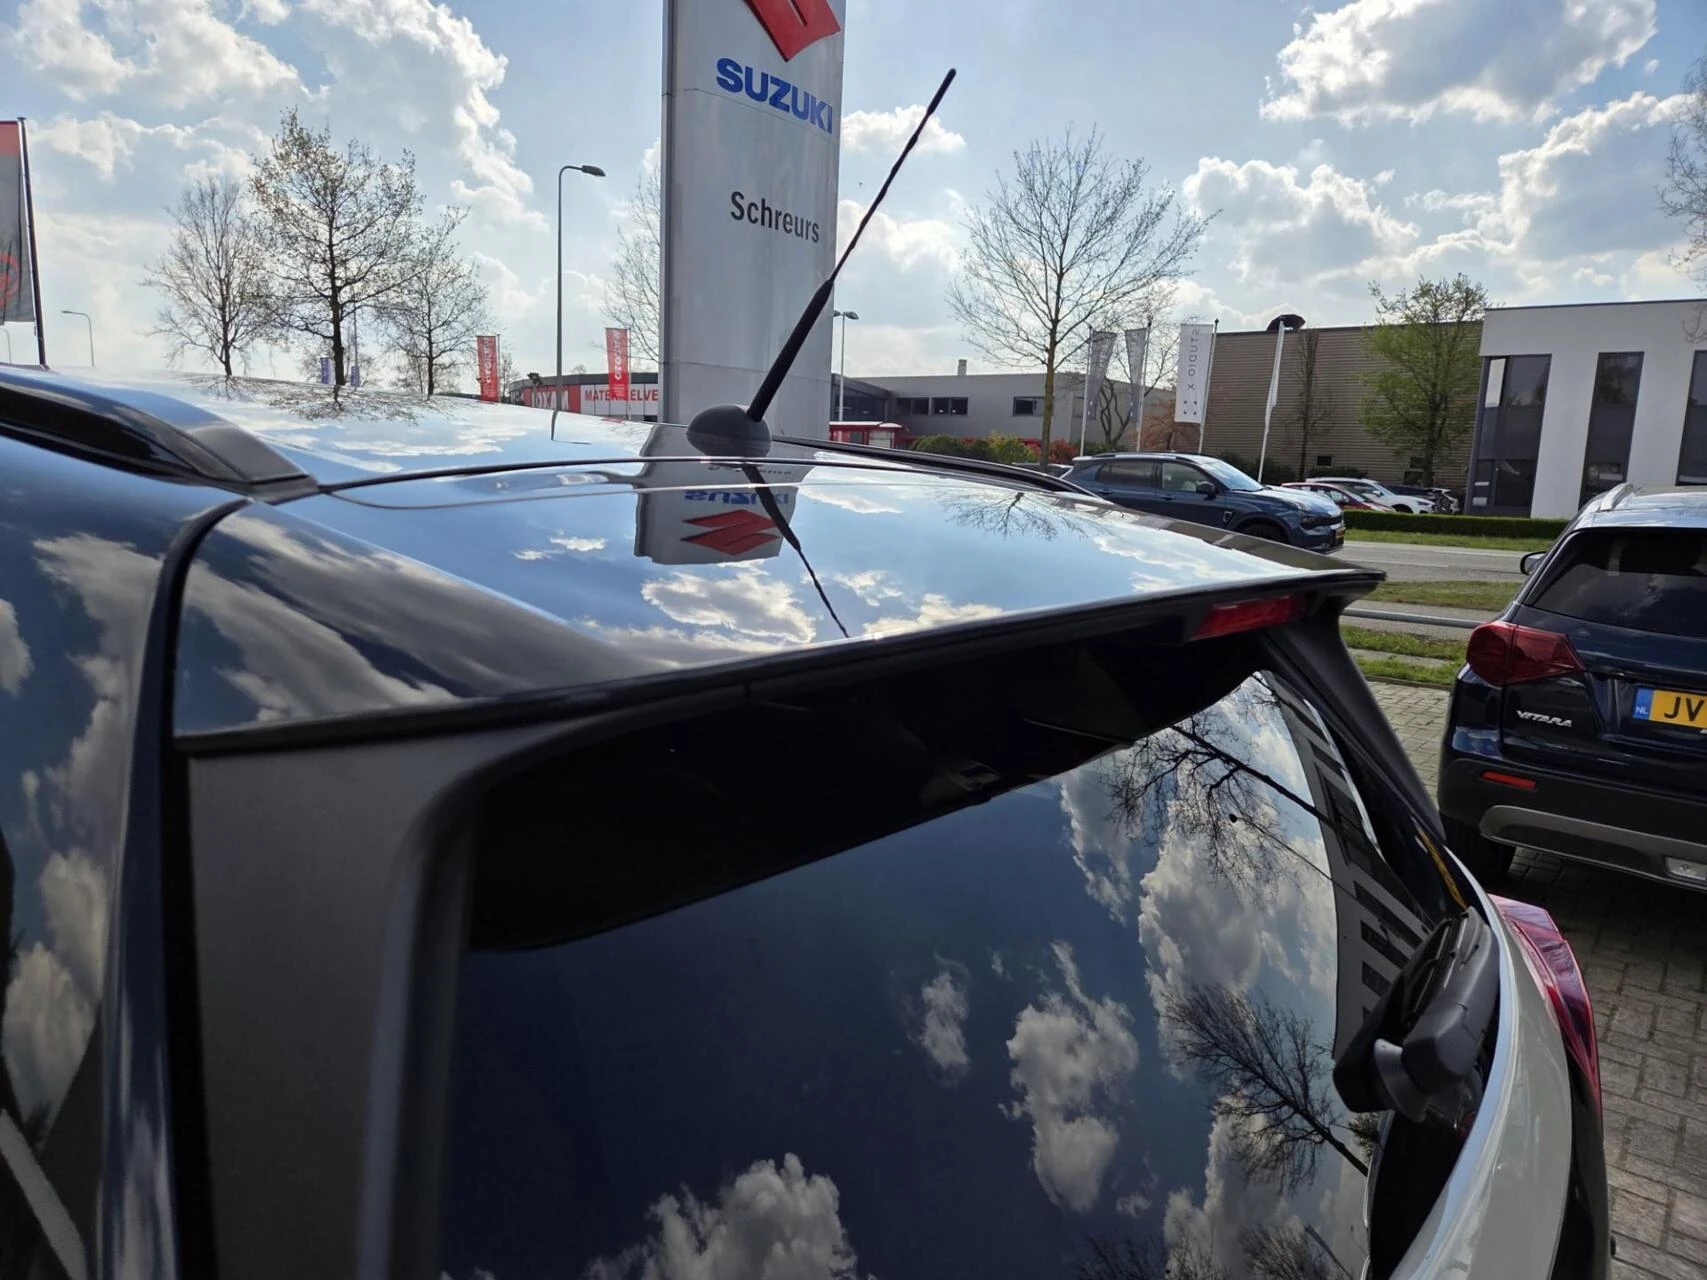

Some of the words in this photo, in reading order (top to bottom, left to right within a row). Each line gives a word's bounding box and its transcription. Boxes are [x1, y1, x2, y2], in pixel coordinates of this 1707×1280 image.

[716, 58, 833, 135] SUZUKI
[730, 191, 820, 244] Schreurs
[1516, 710, 1572, 727] VITARA
[1635, 705, 1648, 715] NL
